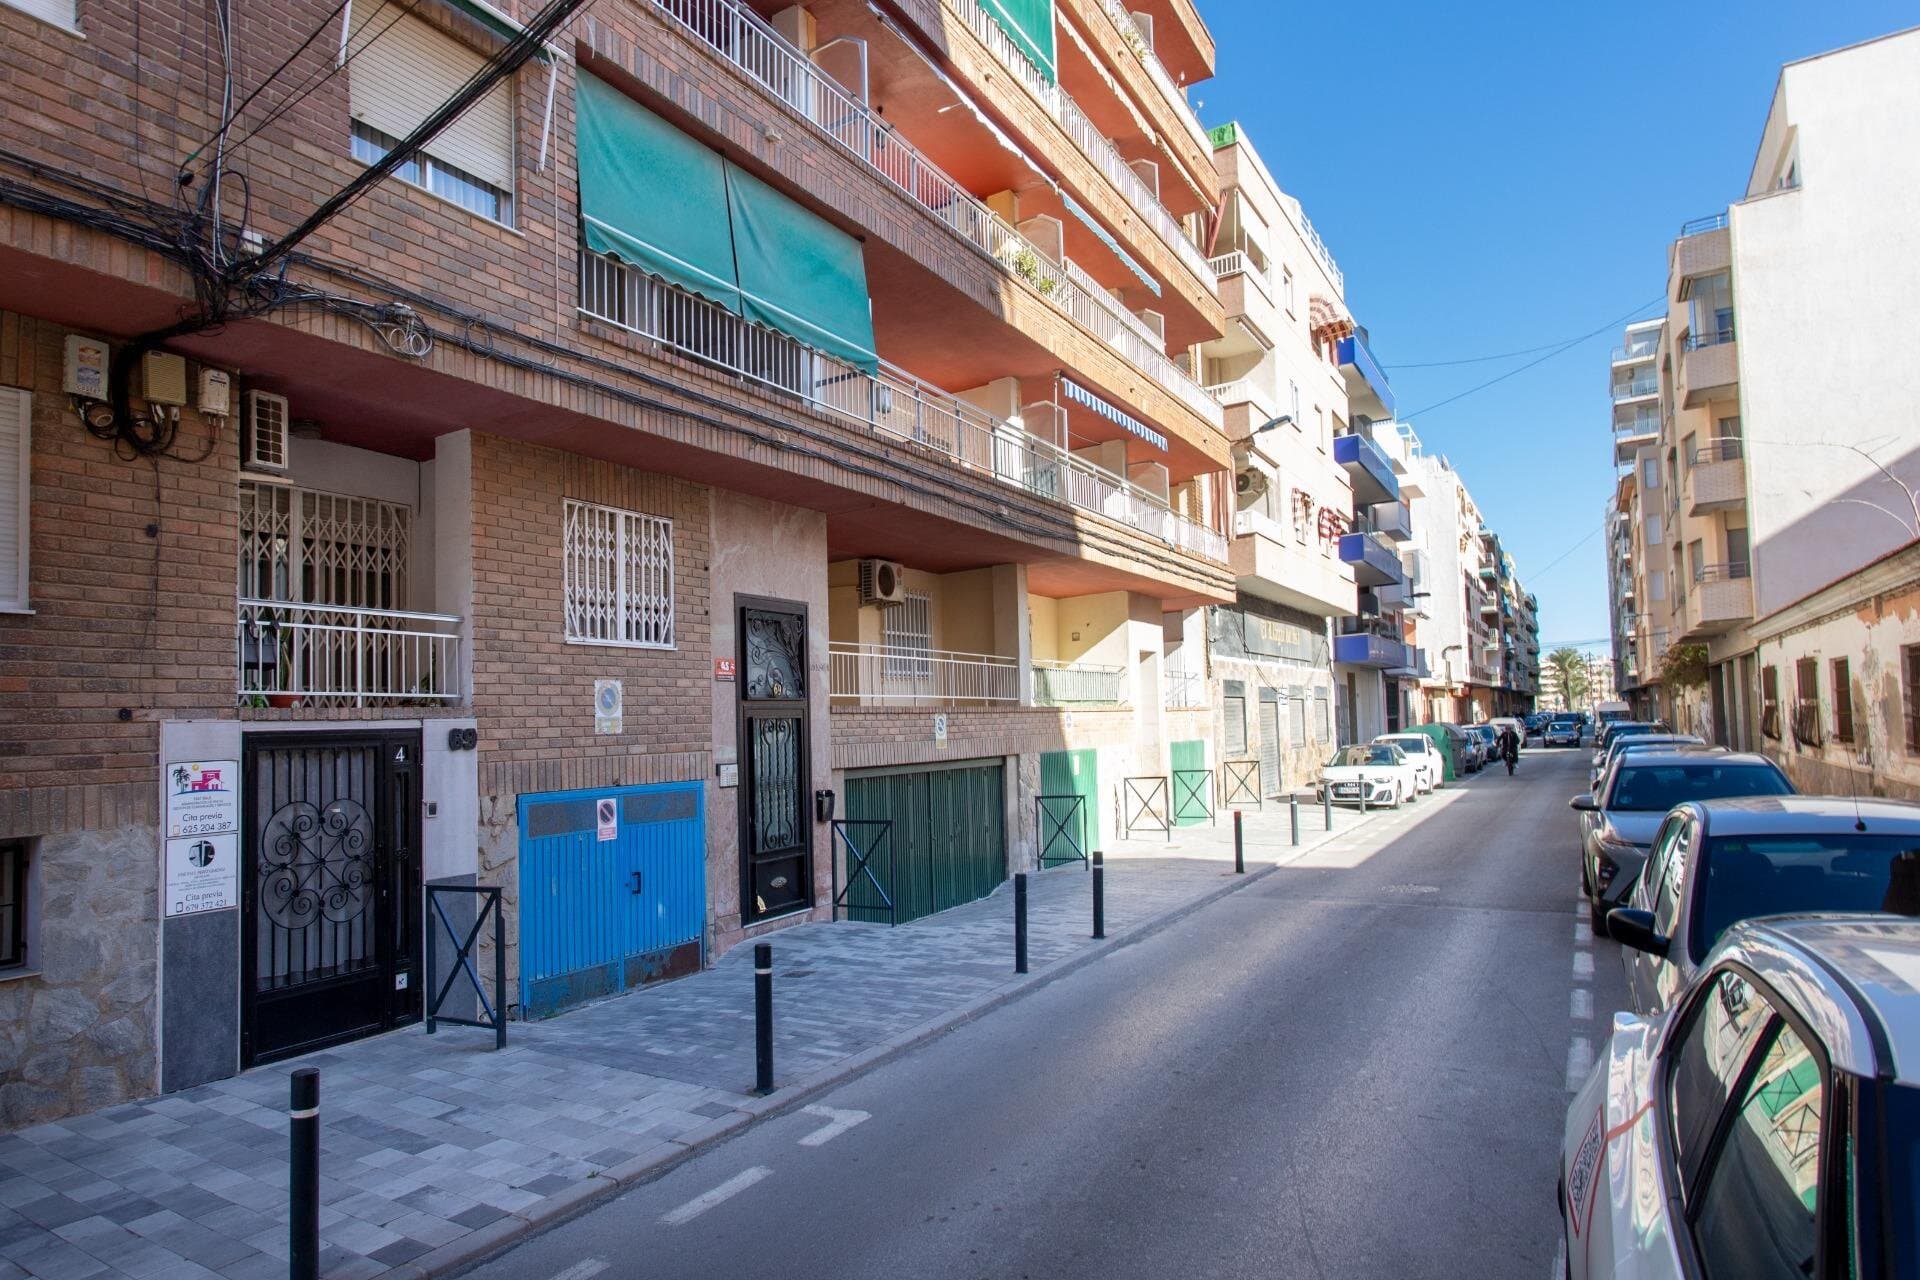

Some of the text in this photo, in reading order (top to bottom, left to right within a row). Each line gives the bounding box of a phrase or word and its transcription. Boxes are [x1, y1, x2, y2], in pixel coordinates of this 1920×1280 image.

[449, 728, 477, 750] 69
[395, 746, 405, 762] 4
[182, 812, 223, 822] Cita previa
[182, 821, 232, 834] 625 204 387
[185, 891, 222, 902] Cita previa
